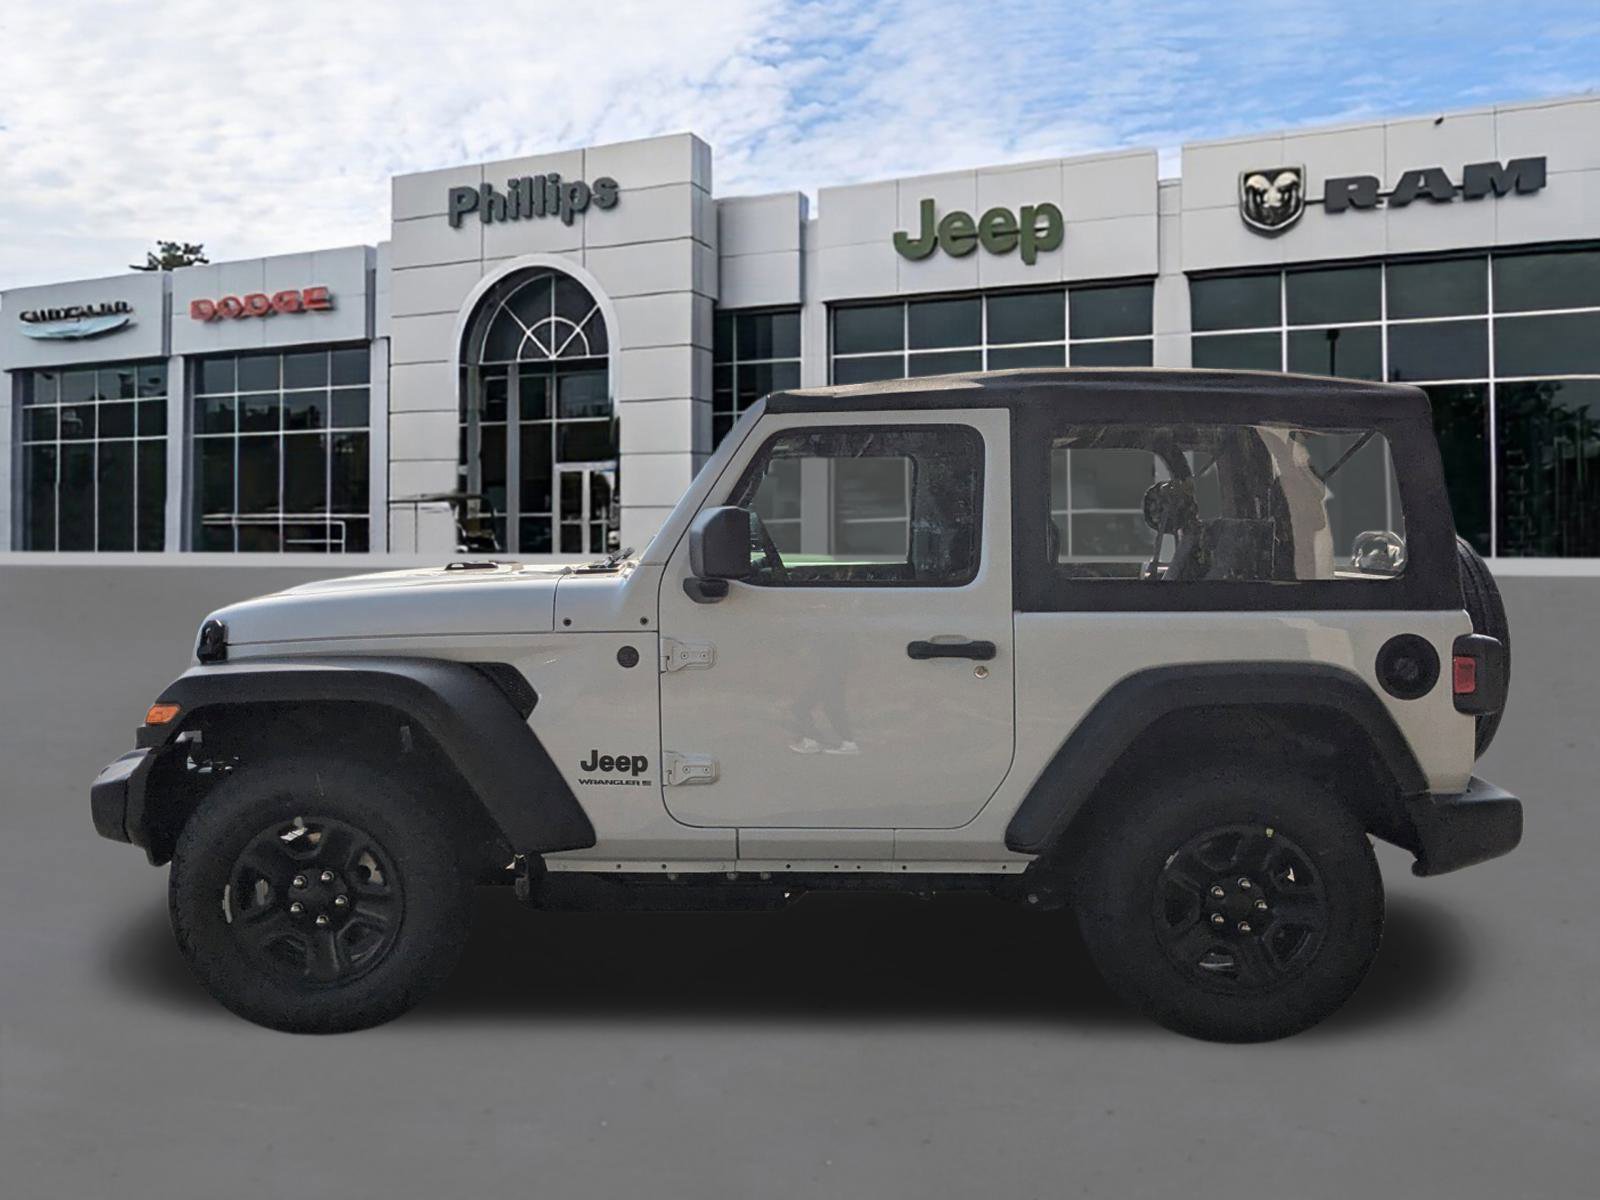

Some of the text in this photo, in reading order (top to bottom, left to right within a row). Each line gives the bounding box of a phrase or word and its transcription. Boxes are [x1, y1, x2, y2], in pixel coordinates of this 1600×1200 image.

[448, 172, 619, 228] Phillips
[1324, 156, 1547, 213] RAM
[893, 198, 1064, 266] Jeep
[190, 286, 332, 322] DODGE
[580, 749, 648, 776] Jeep
